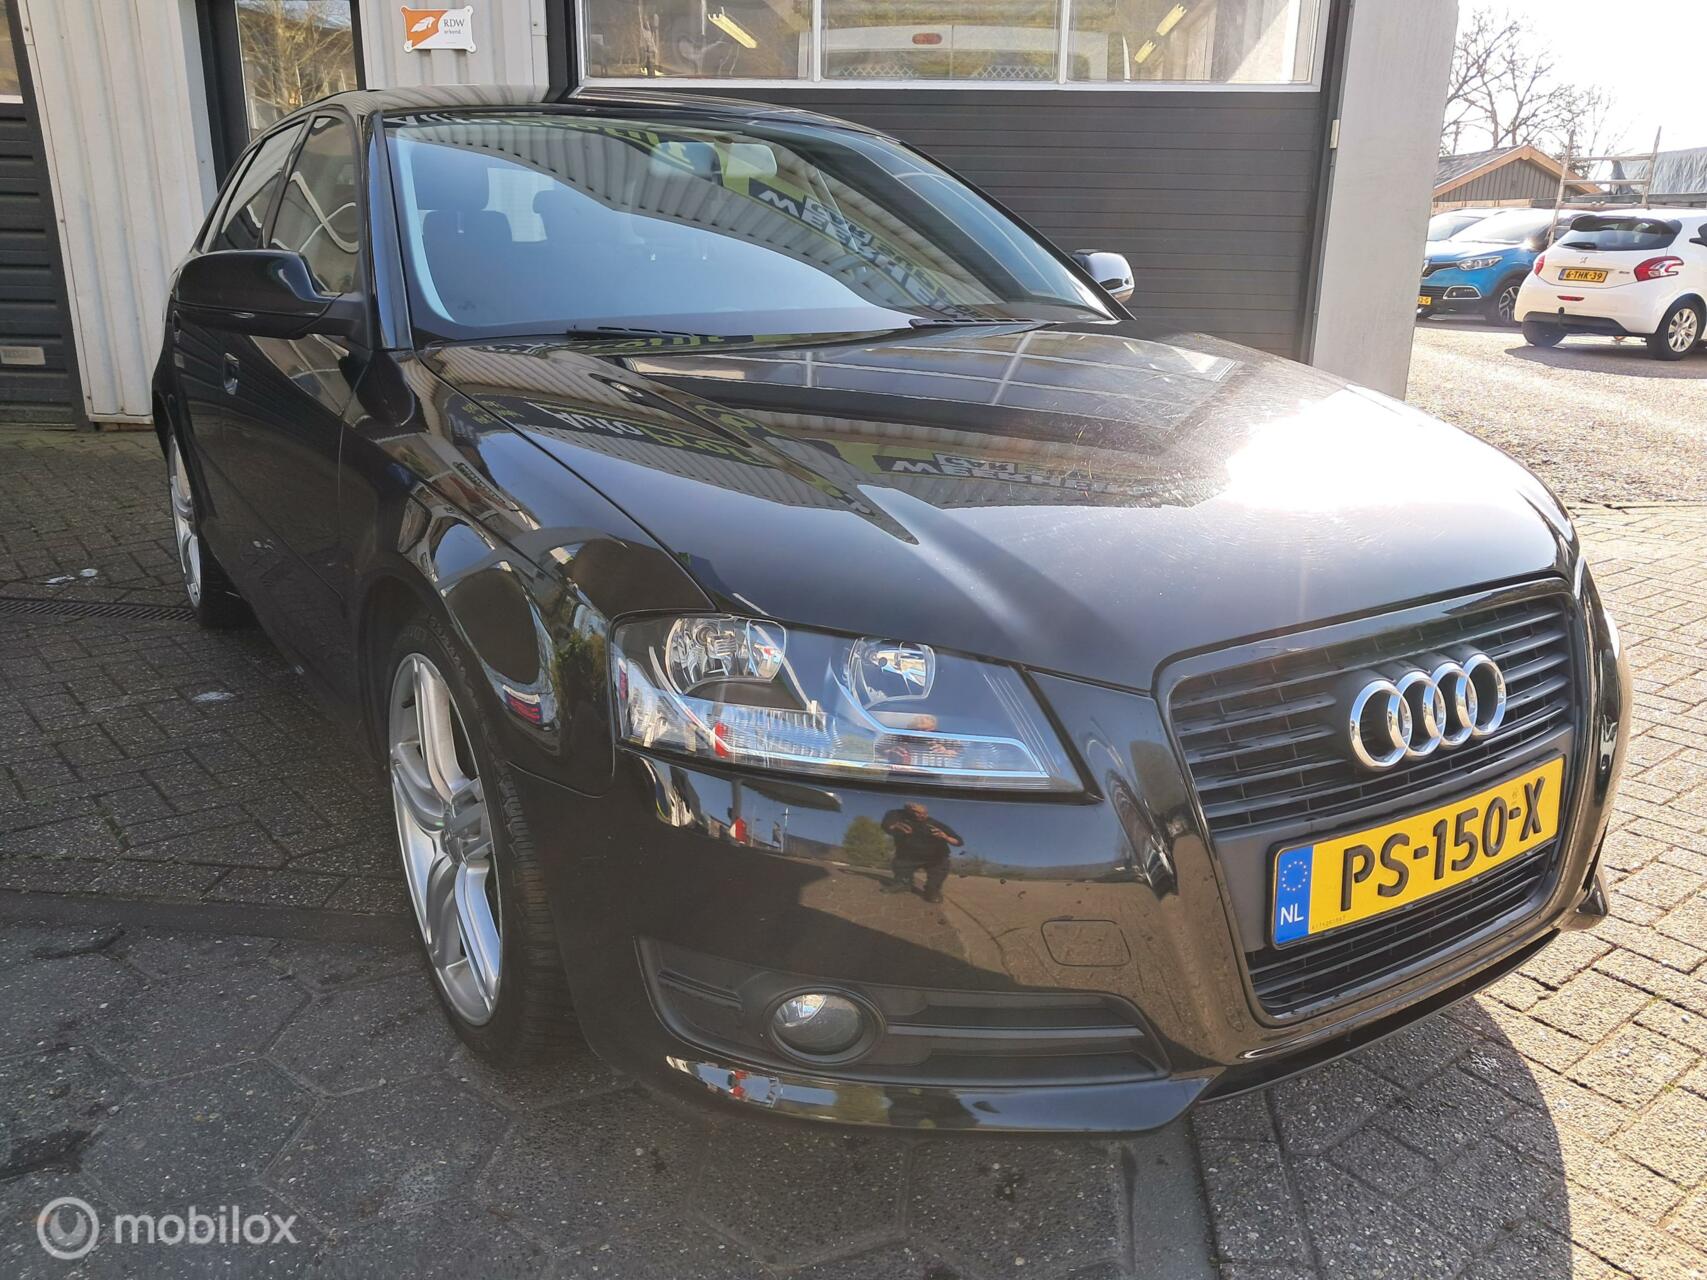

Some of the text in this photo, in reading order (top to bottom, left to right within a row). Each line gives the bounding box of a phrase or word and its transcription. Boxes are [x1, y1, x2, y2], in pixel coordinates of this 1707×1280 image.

[443, 18, 465, 28] RDW
[1565, 269, 1604, 280] 6-THK-39
[1340, 775, 1546, 912] PS-150-X
[1279, 903, 1304, 926] NL
